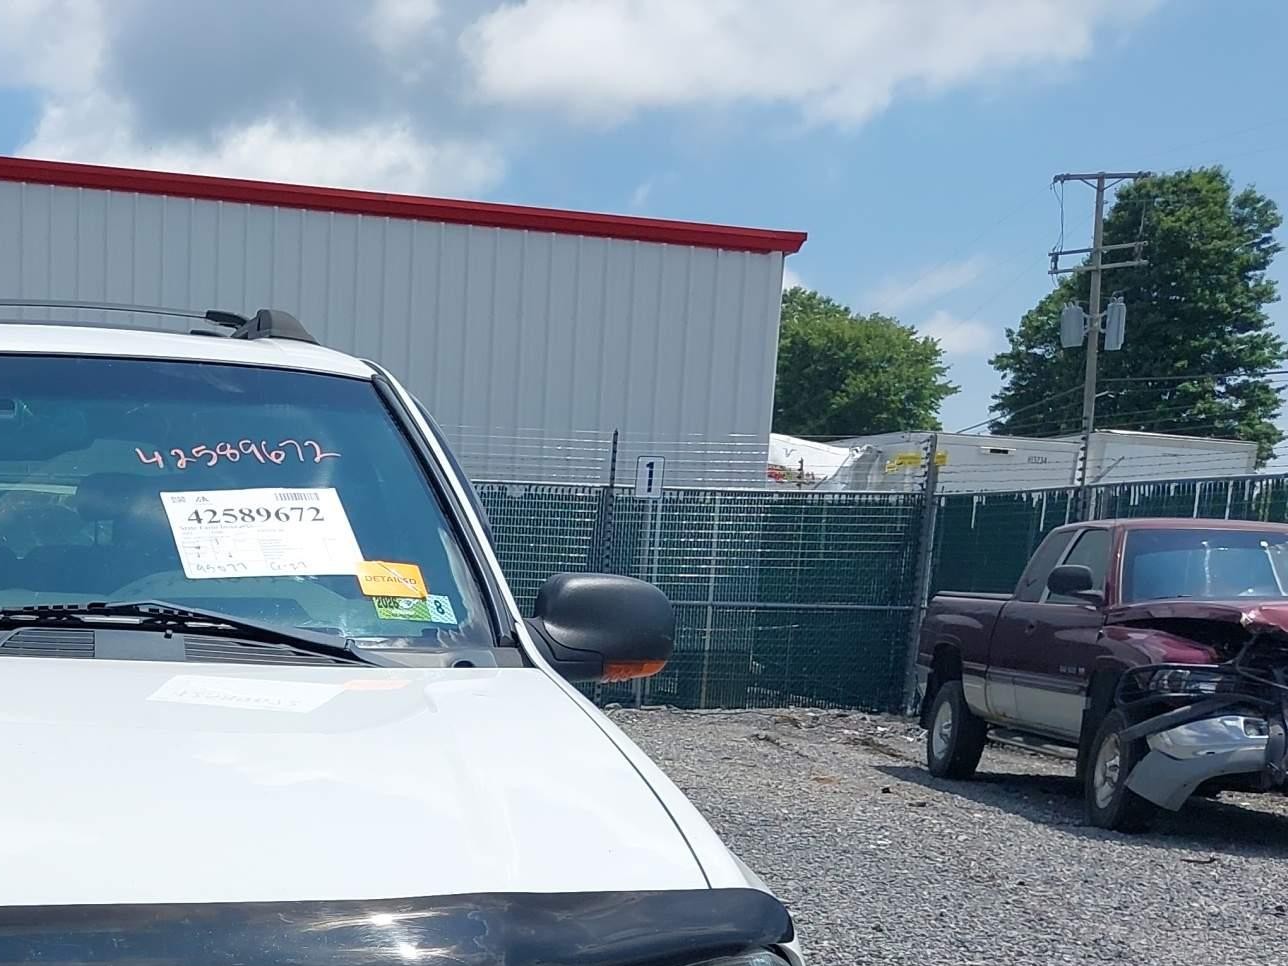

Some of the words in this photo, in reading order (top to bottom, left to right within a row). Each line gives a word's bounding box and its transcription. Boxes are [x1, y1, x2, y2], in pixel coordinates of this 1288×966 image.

[135, 439, 341, 469] 42589672
[646, 461, 655, 493] 1
[187, 506, 325, 525] 42589672
[433, 599, 445, 615] 8
